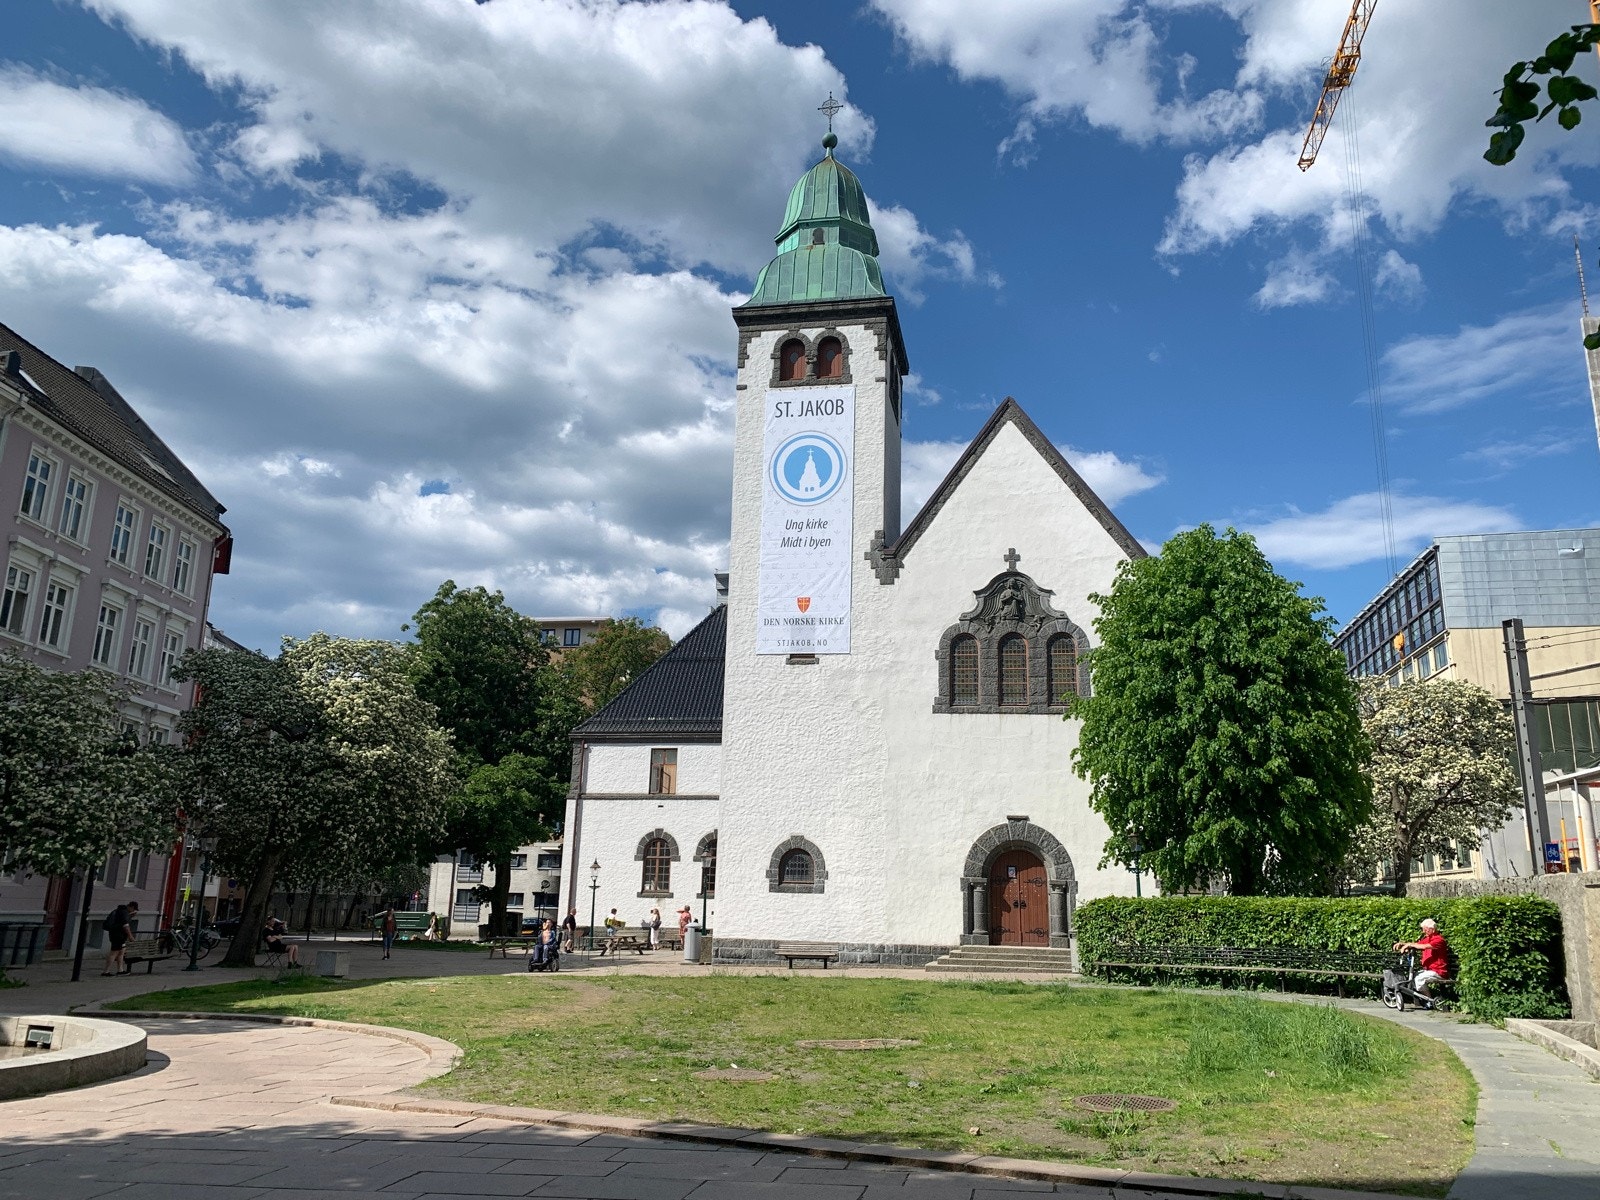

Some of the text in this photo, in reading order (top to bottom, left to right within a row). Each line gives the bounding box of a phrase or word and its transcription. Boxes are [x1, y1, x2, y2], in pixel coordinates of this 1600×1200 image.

[775, 399, 844, 418] ST. JAKOB
[785, 518, 828, 532] Ung kirke
[781, 536, 831, 550] Midt i byen
[763, 616, 845, 626] DEN NORSKE KIRKE
[777, 639, 828, 647] STJAKOB.NO
